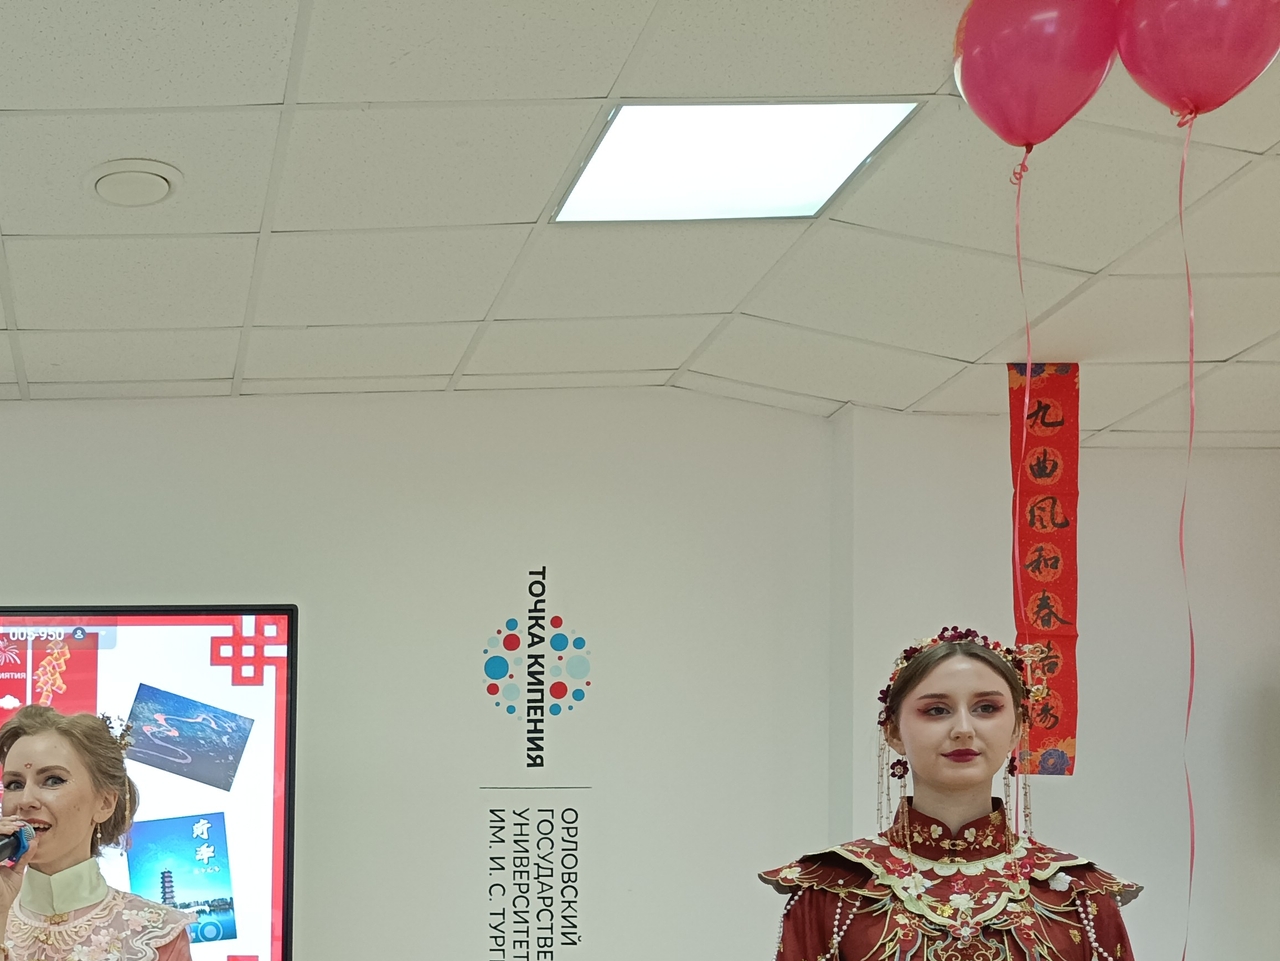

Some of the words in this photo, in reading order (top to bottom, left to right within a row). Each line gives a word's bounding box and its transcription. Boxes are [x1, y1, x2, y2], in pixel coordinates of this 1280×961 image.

[526, 565, 547, 649] ТОЧКА
[9, 627, 65, 641] 005-950
[526, 653, 545, 768] КИПЕНИЯ
[488, 808, 506, 849] ИМ.
[488, 856, 506, 876] И.
[560, 807, 582, 946] ОРЛОВСКИЙ
[488, 883, 506, 901] С.
